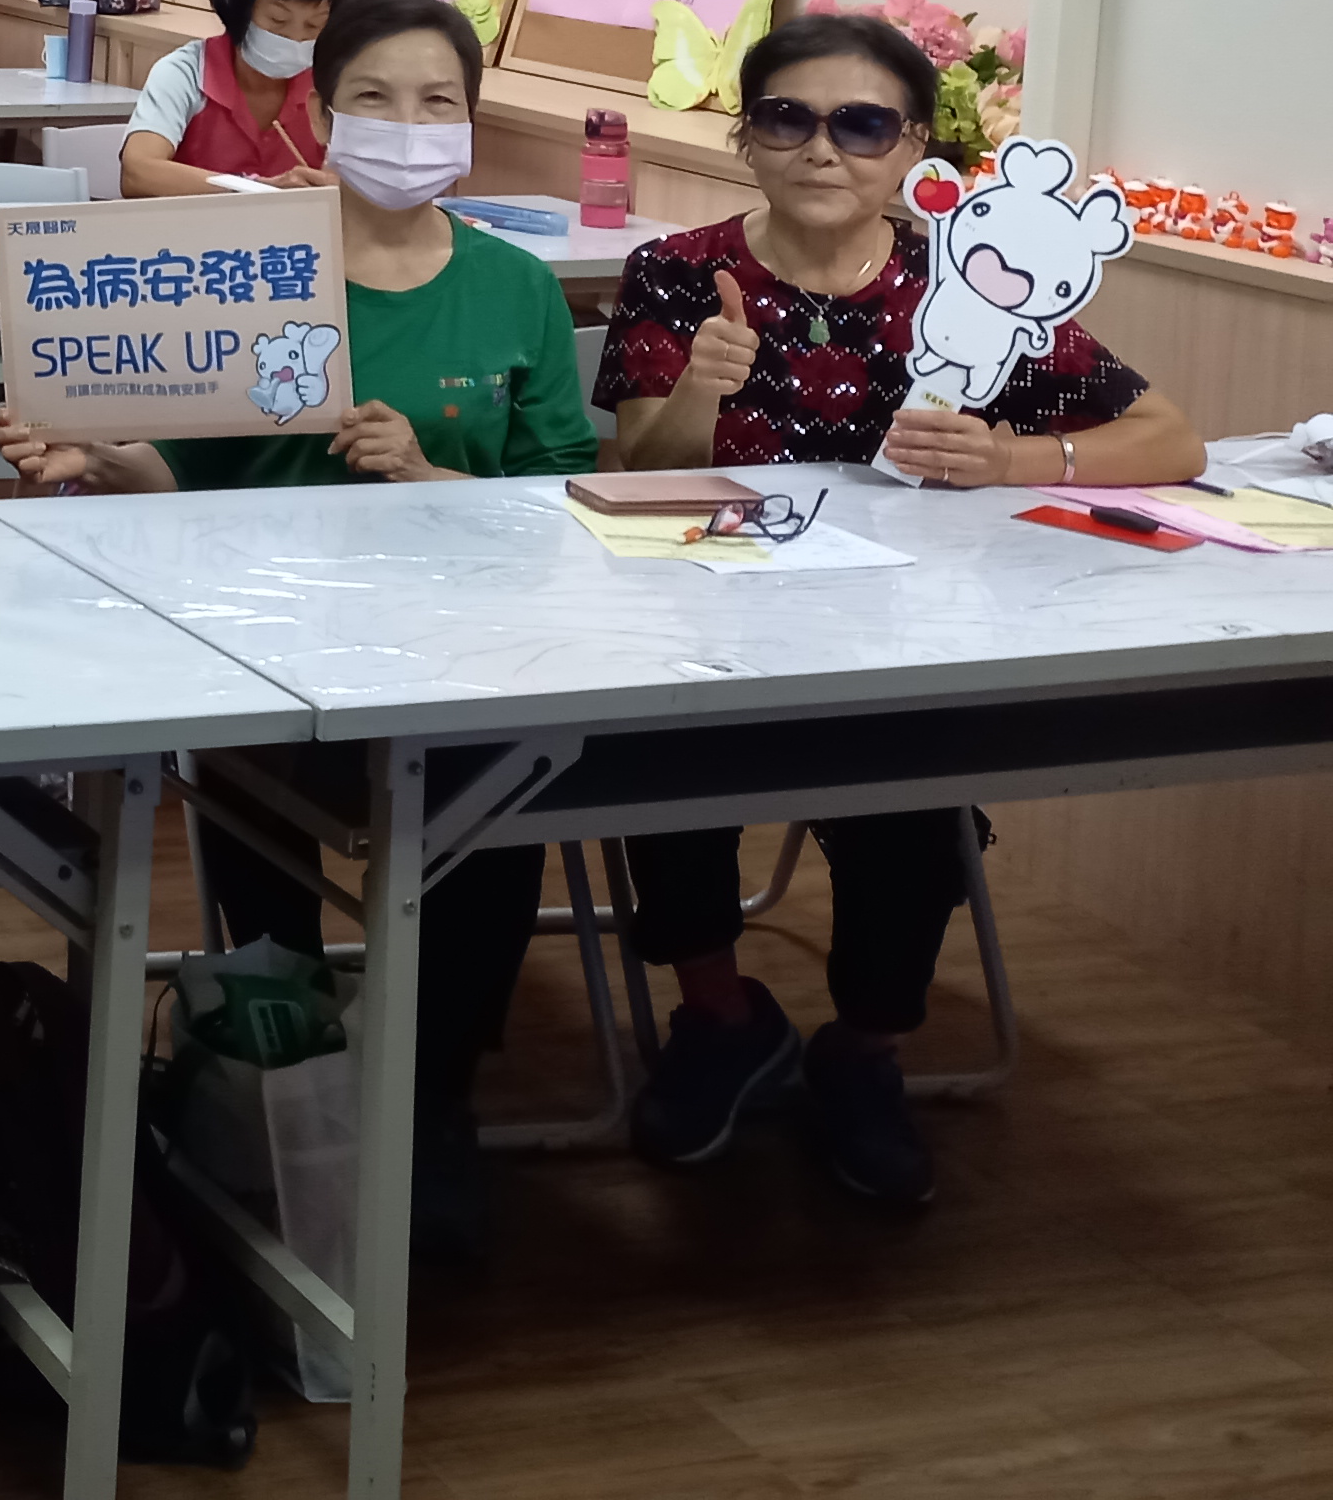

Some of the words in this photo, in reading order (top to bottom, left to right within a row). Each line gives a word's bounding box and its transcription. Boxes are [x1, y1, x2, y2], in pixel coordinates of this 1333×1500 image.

[23, 243, 321, 312] 為病安發聲
[30, 332, 168, 379] SPEAK
[184, 329, 241, 374] UP
